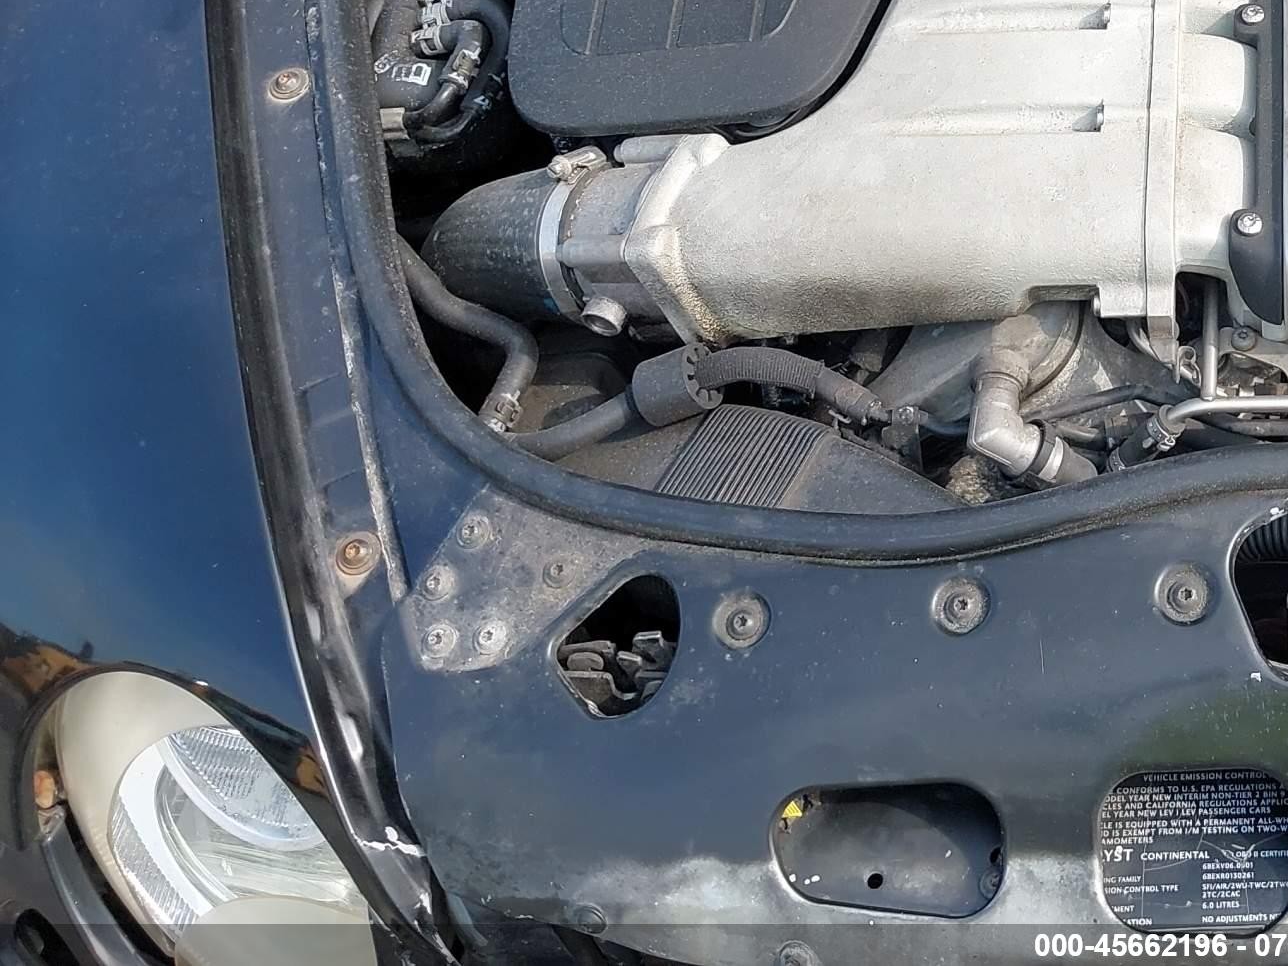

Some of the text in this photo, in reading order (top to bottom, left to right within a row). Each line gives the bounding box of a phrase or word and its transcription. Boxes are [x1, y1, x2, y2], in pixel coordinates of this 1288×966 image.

[1144, 774, 1177, 782] VEHICLE
[1180, 772, 1222, 781] EMISSION
[1117, 786, 1165, 794] CONFORMS
[1218, 783, 1277, 791] REGULATIONS
[1174, 793, 1208, 801] INTERIM
[1199, 799, 1257, 807] REGULATIONS
[1126, 820, 1168, 828] EQUIPPED
[1170, 819, 1192, 827] WITH
[1204, 818, 1255, 826] PERMANENT
[1202, 826, 1238, 834] TESTING
[1101, 836, 1153, 845] AMOMETERS
[1141, 851, 1210, 861] CONTINENTAL
[1124, 885, 1159, 894] CONTROL
[1202, 891, 1240, 899] 2TC/2CAC
[1216, 913, 1267, 923] ADJUSTMENTS
